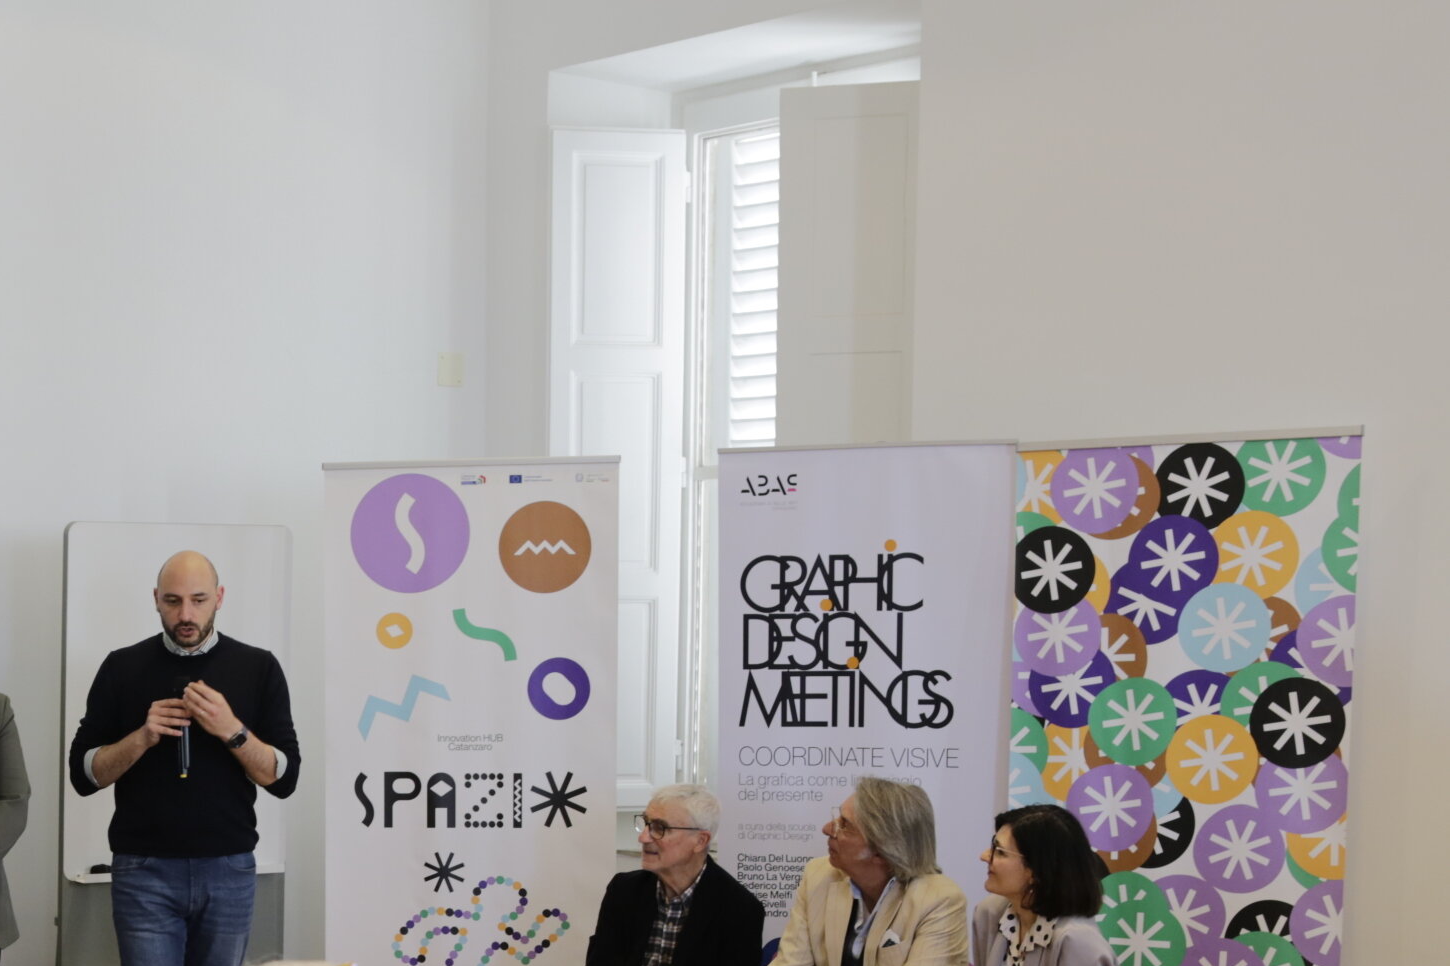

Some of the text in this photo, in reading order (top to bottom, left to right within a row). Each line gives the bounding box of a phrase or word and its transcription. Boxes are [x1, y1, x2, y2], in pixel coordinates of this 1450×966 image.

[740, 550, 925, 613] GRAPHIC
[743, 611, 903, 671] DESIGN
[739, 669, 954, 729] MEETINGS
[437, 733, 504, 743] Innovation HUB
[447, 742, 493, 751] Catanzaro
[739, 746, 959, 768] COORDINATE VISIVE
[738, 773, 754, 786] La
[758, 773, 804, 789] grafica
[808, 776, 847, 787] come
[738, 789, 823, 803] del presente
[737, 853, 767, 862] Chiara
[768, 854, 784, 862] Del
[737, 863, 763, 871] Paolo
[737, 872, 764, 880] Bruno
[740, 881, 777, 890] ederico
[770, 891, 793, 899] Melfi
